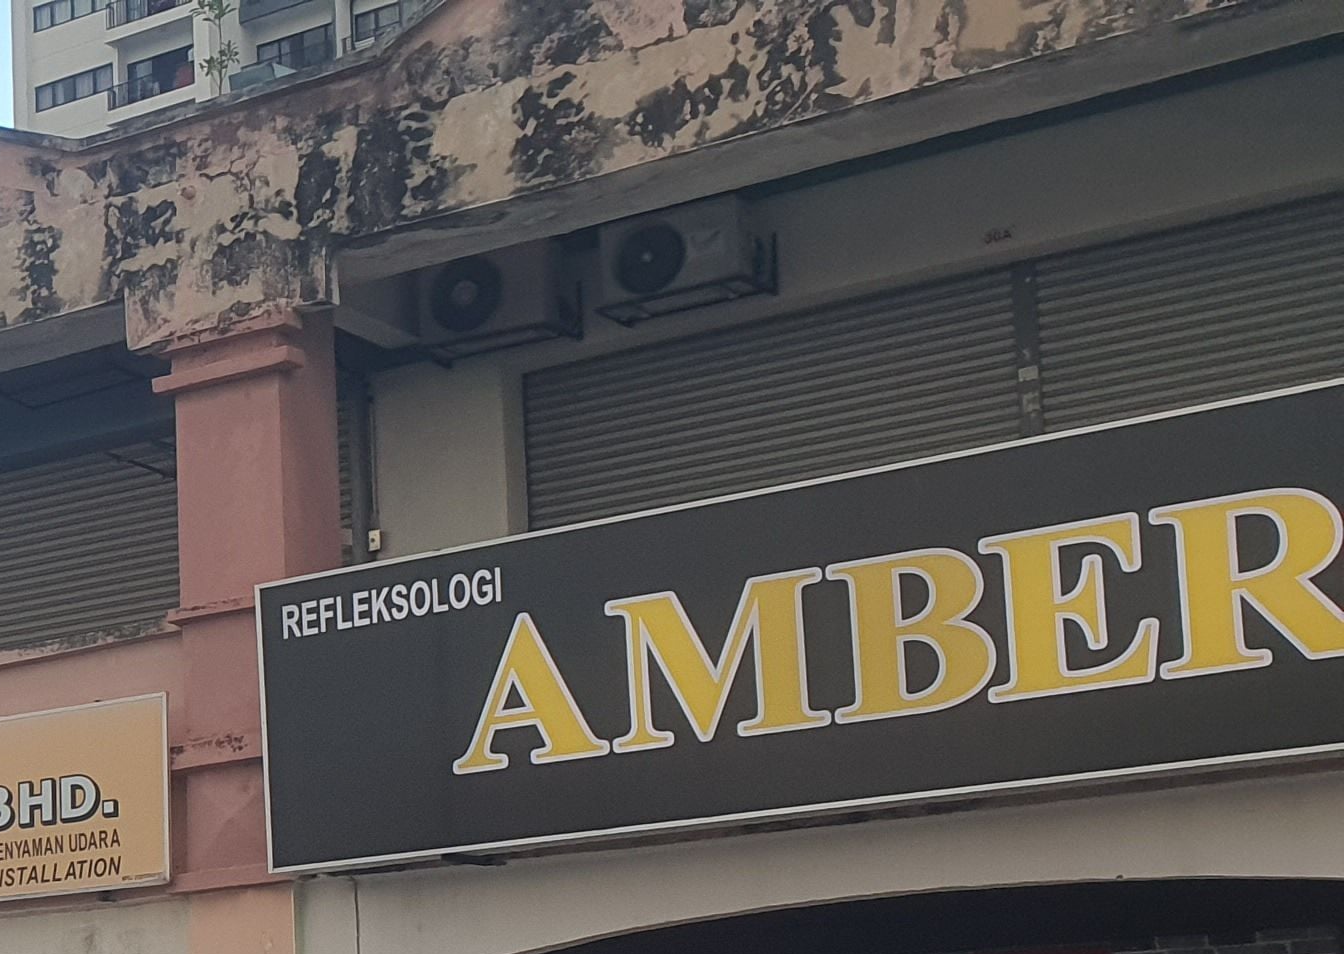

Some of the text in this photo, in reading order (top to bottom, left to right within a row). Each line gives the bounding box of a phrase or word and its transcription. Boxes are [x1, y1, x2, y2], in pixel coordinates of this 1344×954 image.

[280, 565, 503, 641] REFLEKSOLOGI
[452, 486, 1344, 775] AMBER
[68, 828, 121, 853] UDARA
